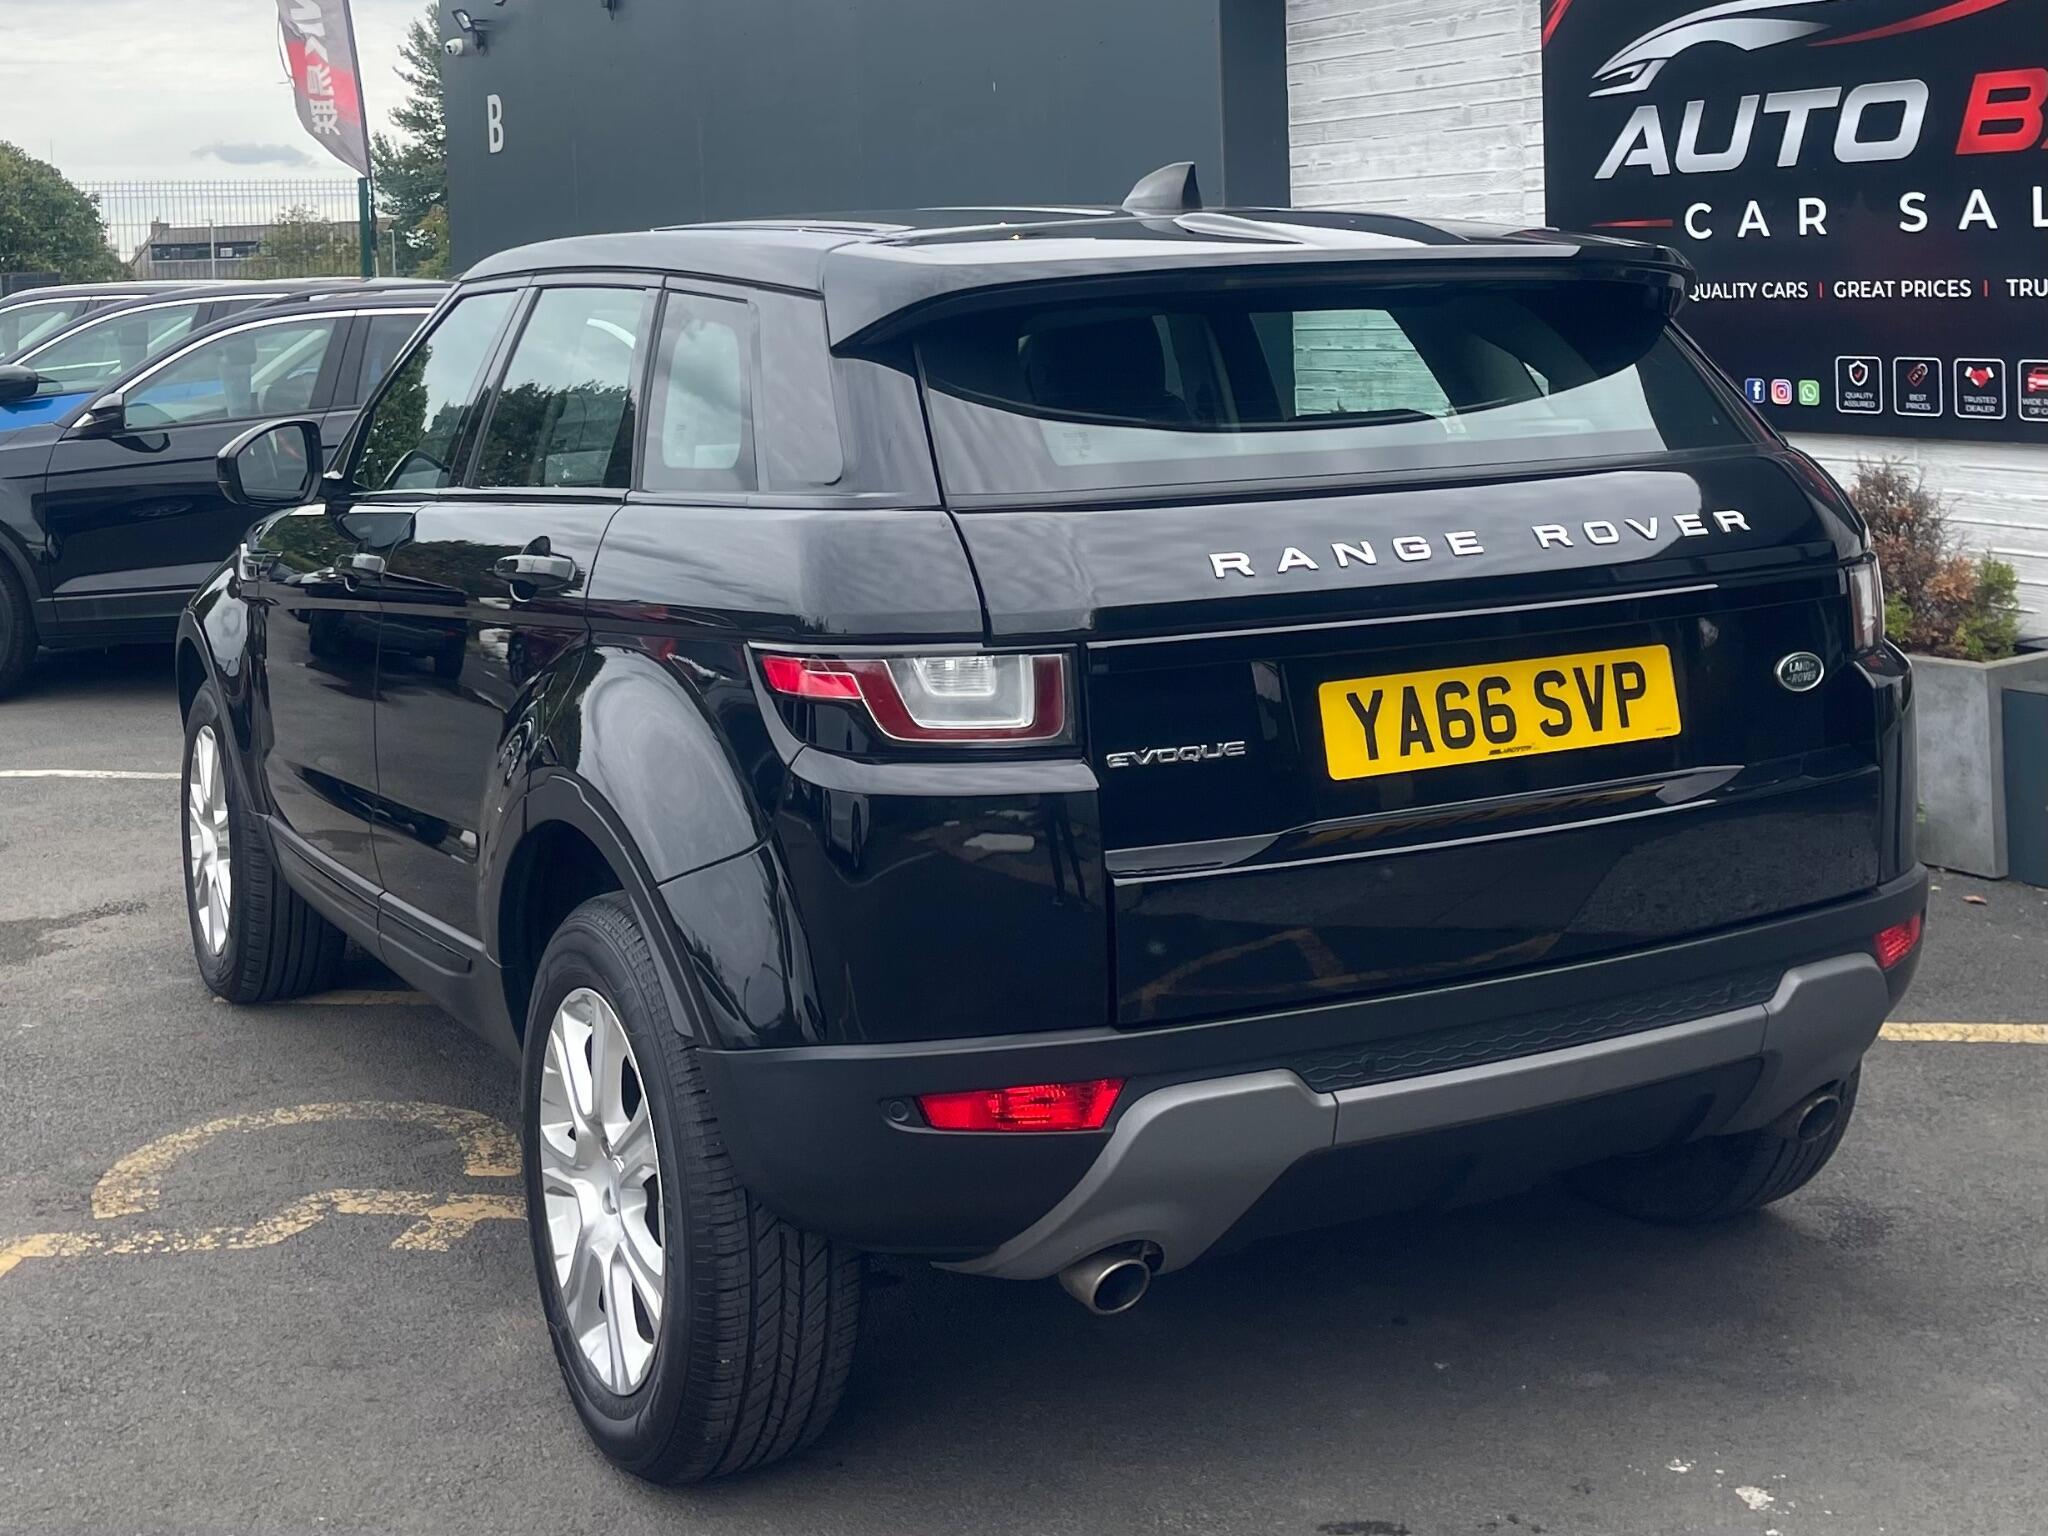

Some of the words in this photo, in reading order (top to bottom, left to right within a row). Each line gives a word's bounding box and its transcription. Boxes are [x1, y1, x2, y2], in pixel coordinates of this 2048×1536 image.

[487, 93, 504, 153] B
[1594, 79, 1929, 179] AUTO
[1955, 67, 2048, 155] B
[1684, 197, 1827, 240] CAR
[1761, 282, 1808, 298] CARS
[1833, 281, 1896, 298] GREAT
[1900, 279, 1972, 298] PRICES
[1844, 400, 1875, 408] ASSURED
[1845, 391, 1873, 399] QUALITY
[1963, 395, 1997, 404] TRUSTED
[1905, 402, 1931, 410] PRICES
[1965, 404, 1995, 412] DEALER
[1209, 528, 1485, 579] RANGE
[1531, 509, 1752, 549] ROVER
[1789, 660, 1810, 673] LAND
[1345, 675, 1517, 761] YA66
[1533, 660, 1647, 738] SVP
[1106, 740, 1246, 769] EVOQUE
